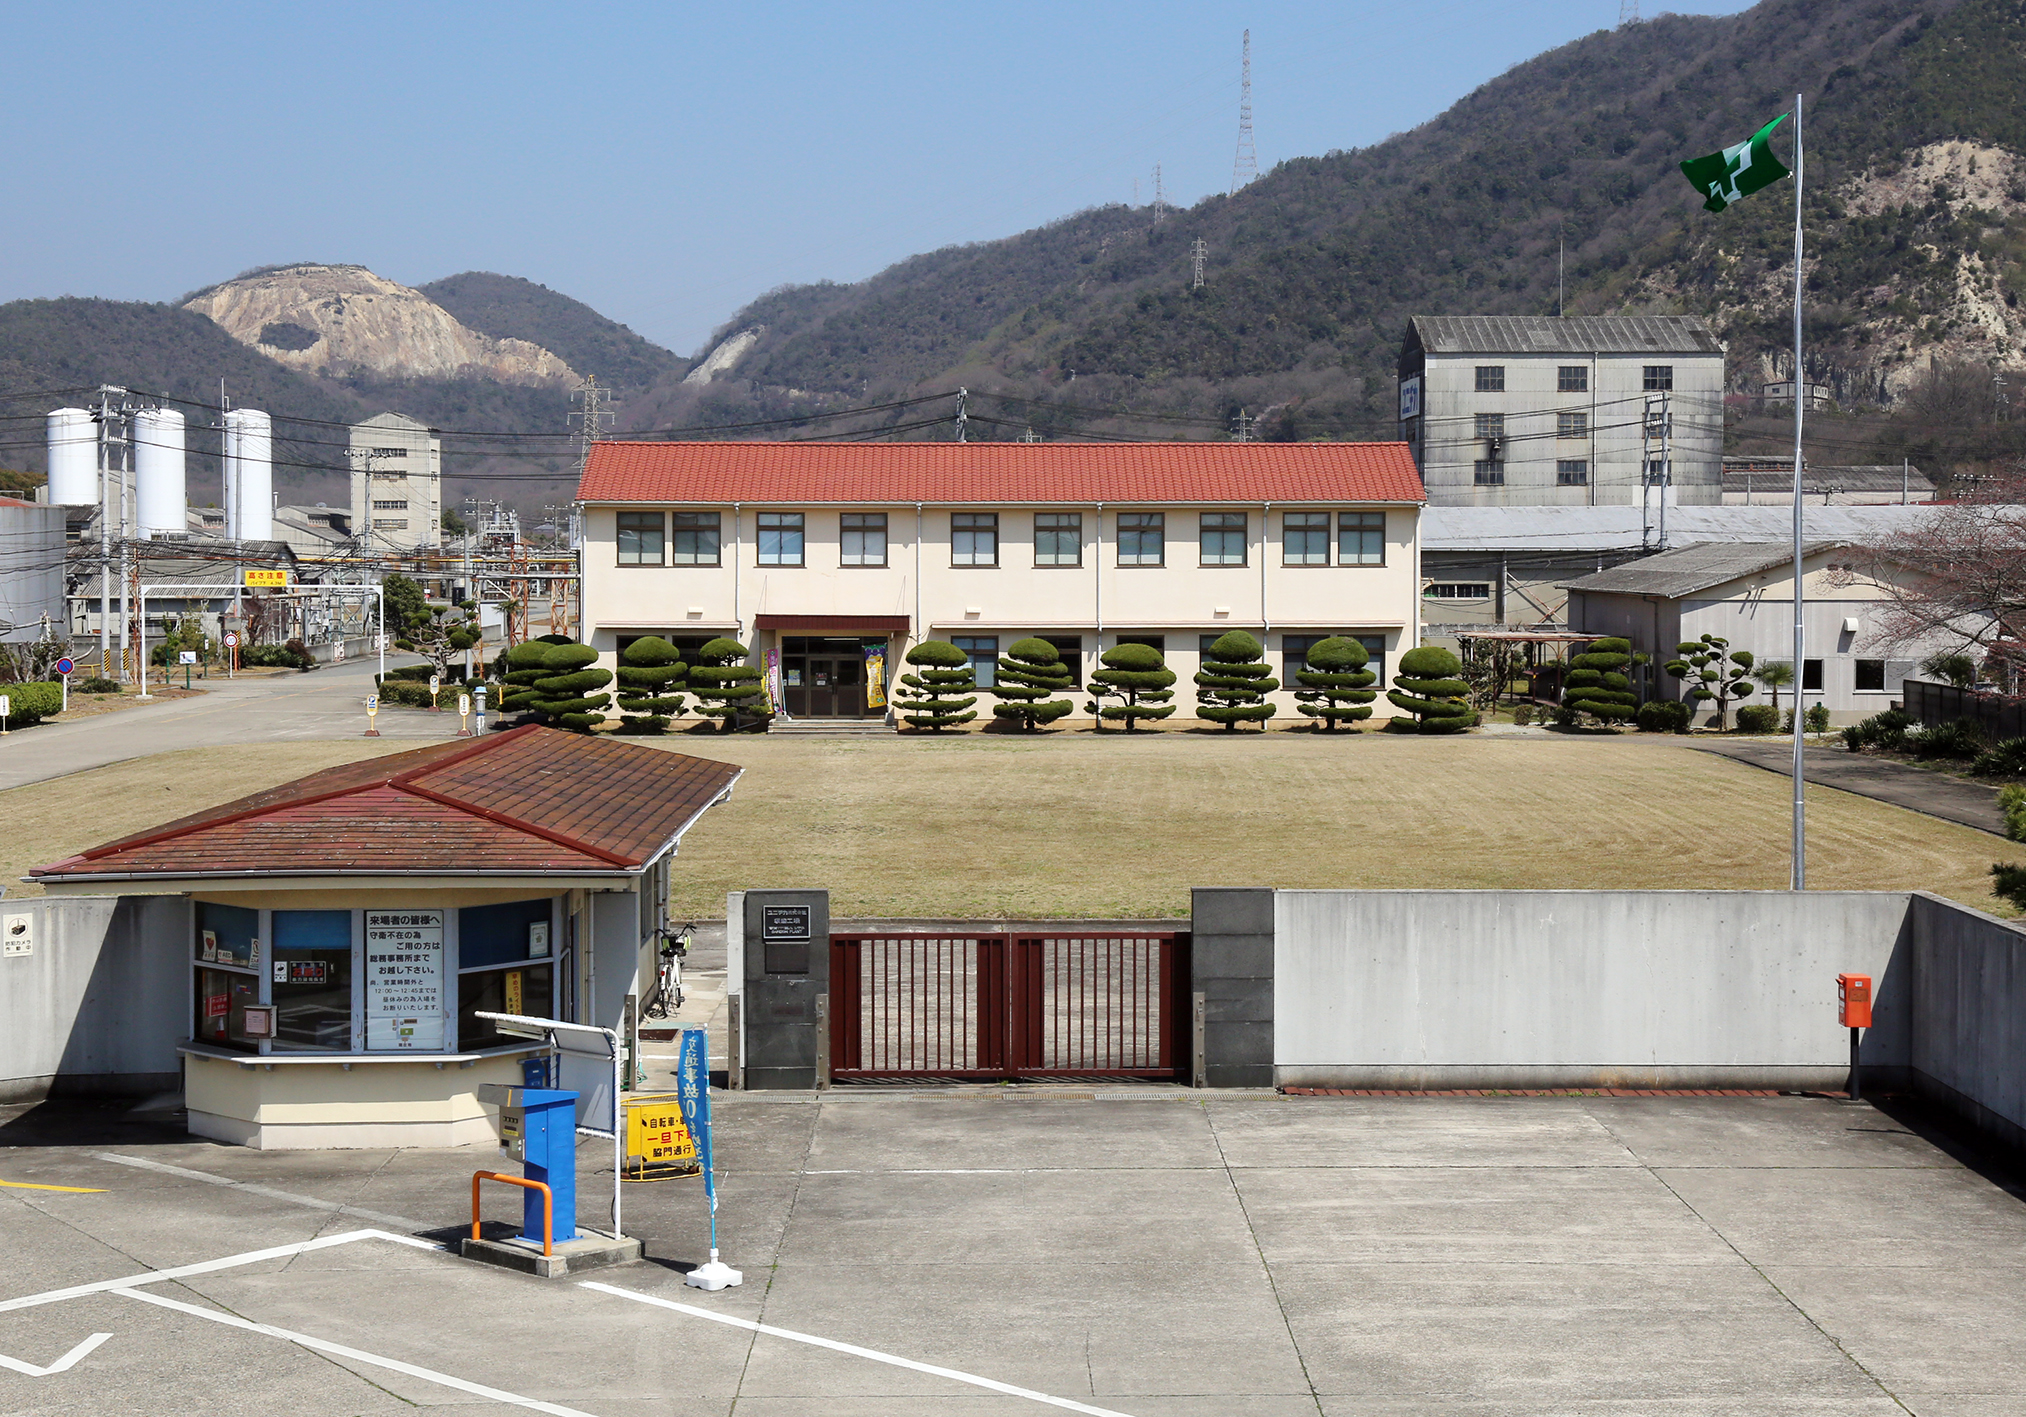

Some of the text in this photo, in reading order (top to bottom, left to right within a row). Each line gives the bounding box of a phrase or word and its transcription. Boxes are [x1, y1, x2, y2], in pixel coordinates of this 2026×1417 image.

[369, 915, 440, 925] 来場者の皆様へ
[369, 931, 421, 939] 守衛不在の為
[396, 942, 440, 950] ご用の方は
[369, 954, 430, 962] 総務事務所まで
[292, 967, 323, 977] お断り
[378, 966, 434, 974] お越し下さい。
[653, 1144, 691, 1157] 脇門通行
